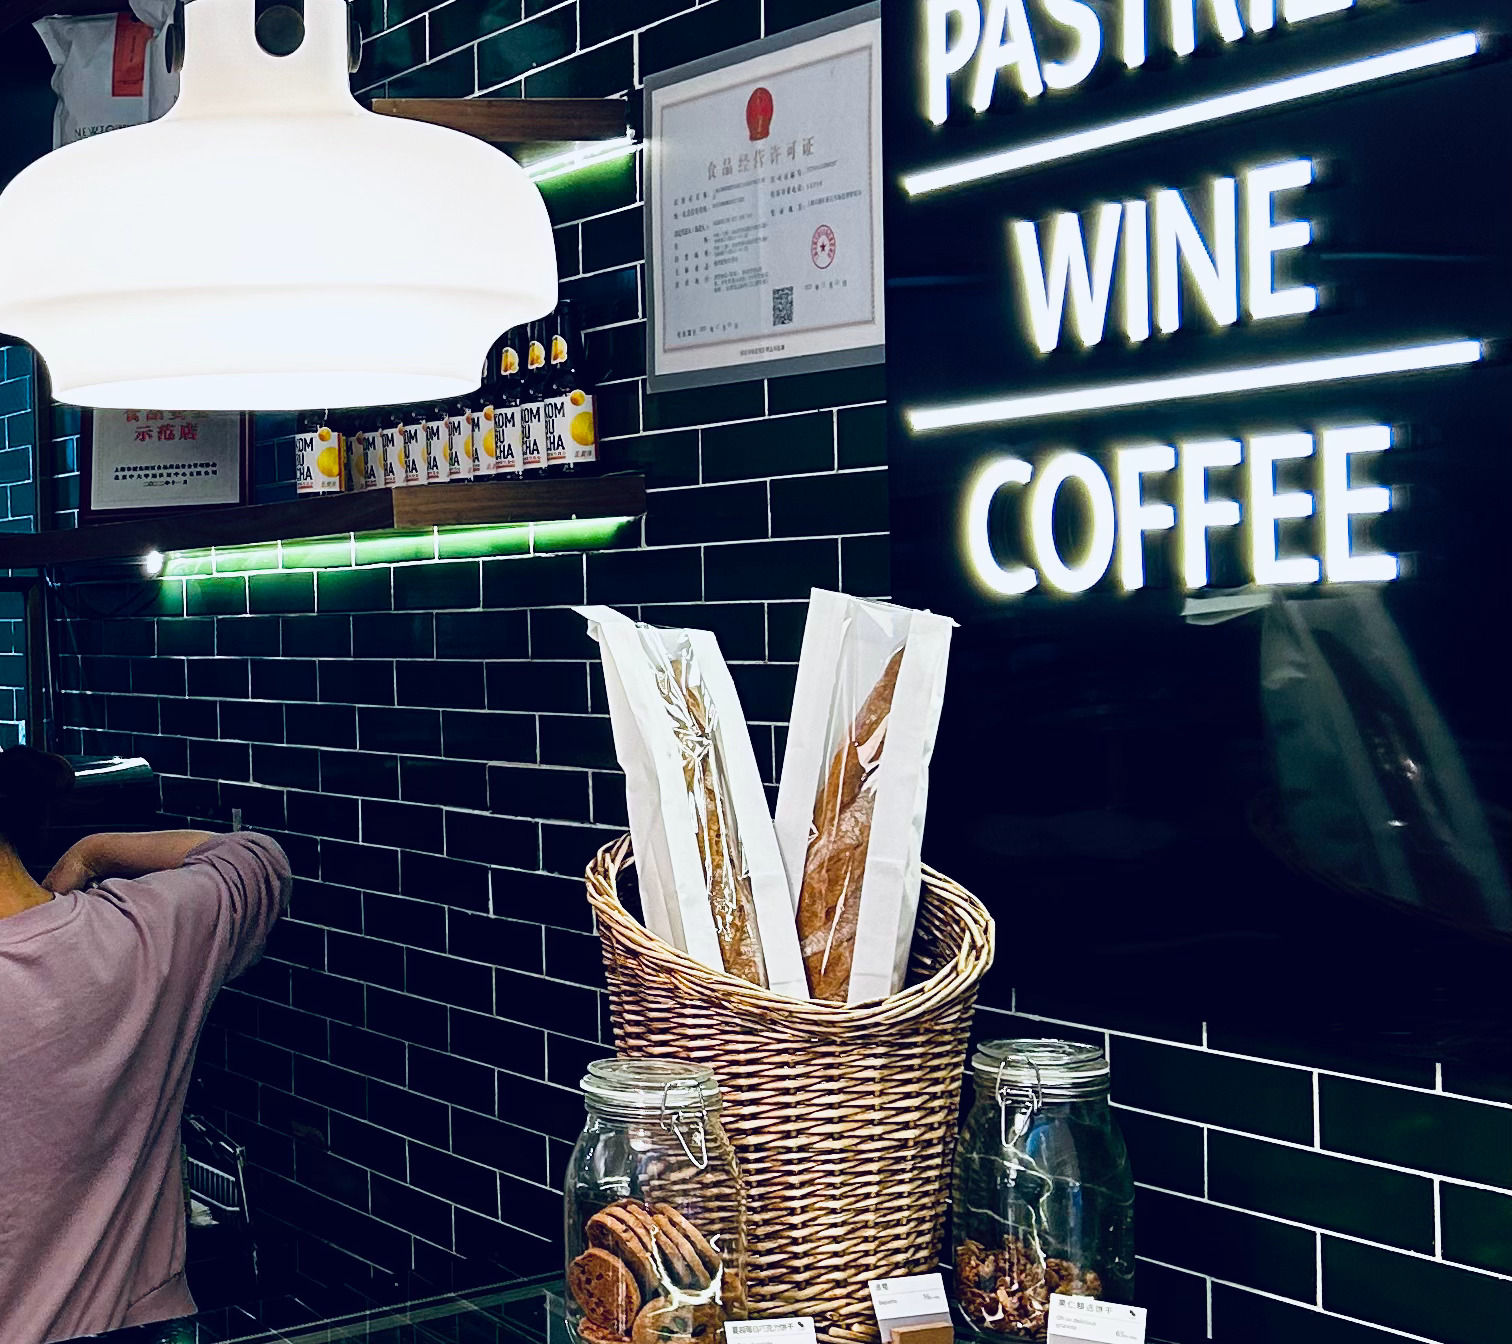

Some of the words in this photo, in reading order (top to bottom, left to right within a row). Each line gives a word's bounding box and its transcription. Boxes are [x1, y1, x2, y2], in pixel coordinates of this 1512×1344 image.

[1013, 156, 1320, 355] WINE
[134, 422, 199, 441] 示范店
[966, 423, 1399, 596] COFFEE
